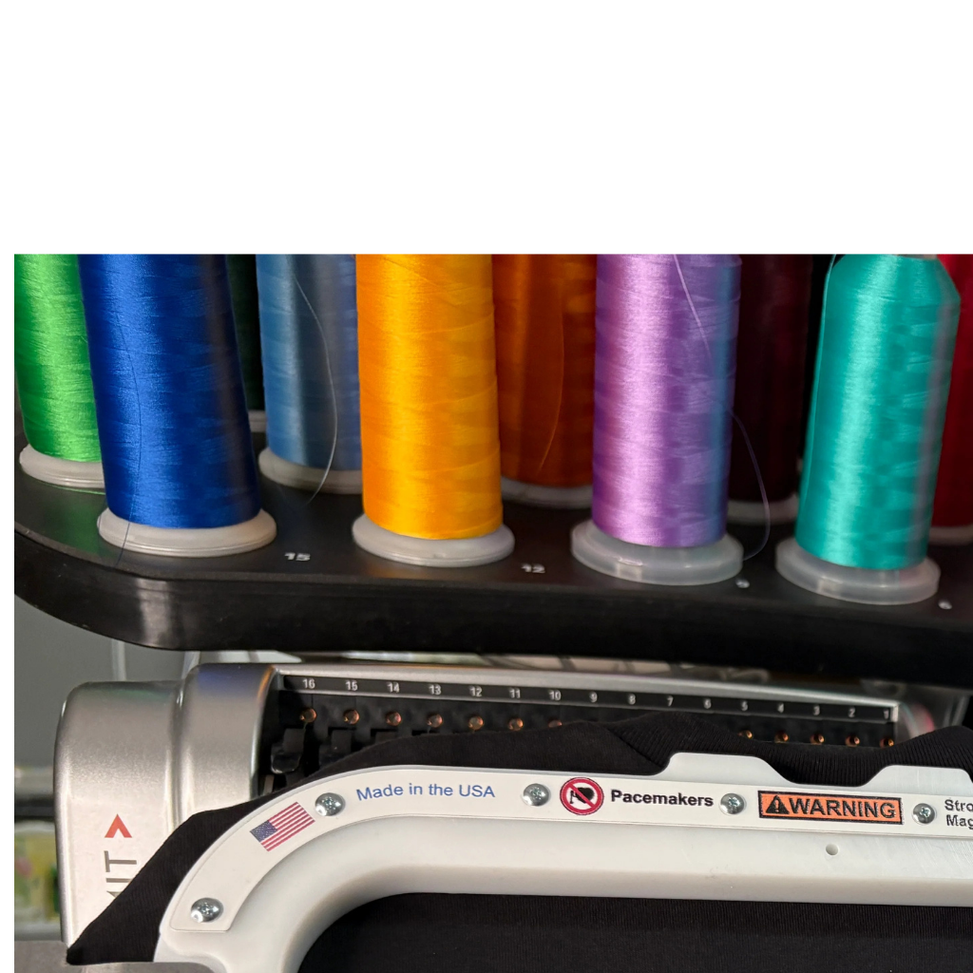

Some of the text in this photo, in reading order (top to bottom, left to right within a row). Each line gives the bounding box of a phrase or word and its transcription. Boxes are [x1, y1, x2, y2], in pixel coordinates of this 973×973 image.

[284, 552, 311, 562] 15
[521, 563, 546, 575] 12
[303, 679, 316, 690] 16
[345, 681, 358, 691] 15
[387, 682, 400, 693] 14
[429, 684, 441, 696] 13
[470, 686, 482, 697] 12
[509, 688, 521, 698] 11
[550, 690, 562, 701] 10
[356, 783, 495, 801] Made in the USA
[610, 789, 714, 807] Pacemakers
[788, 797, 896, 819] WARNING
